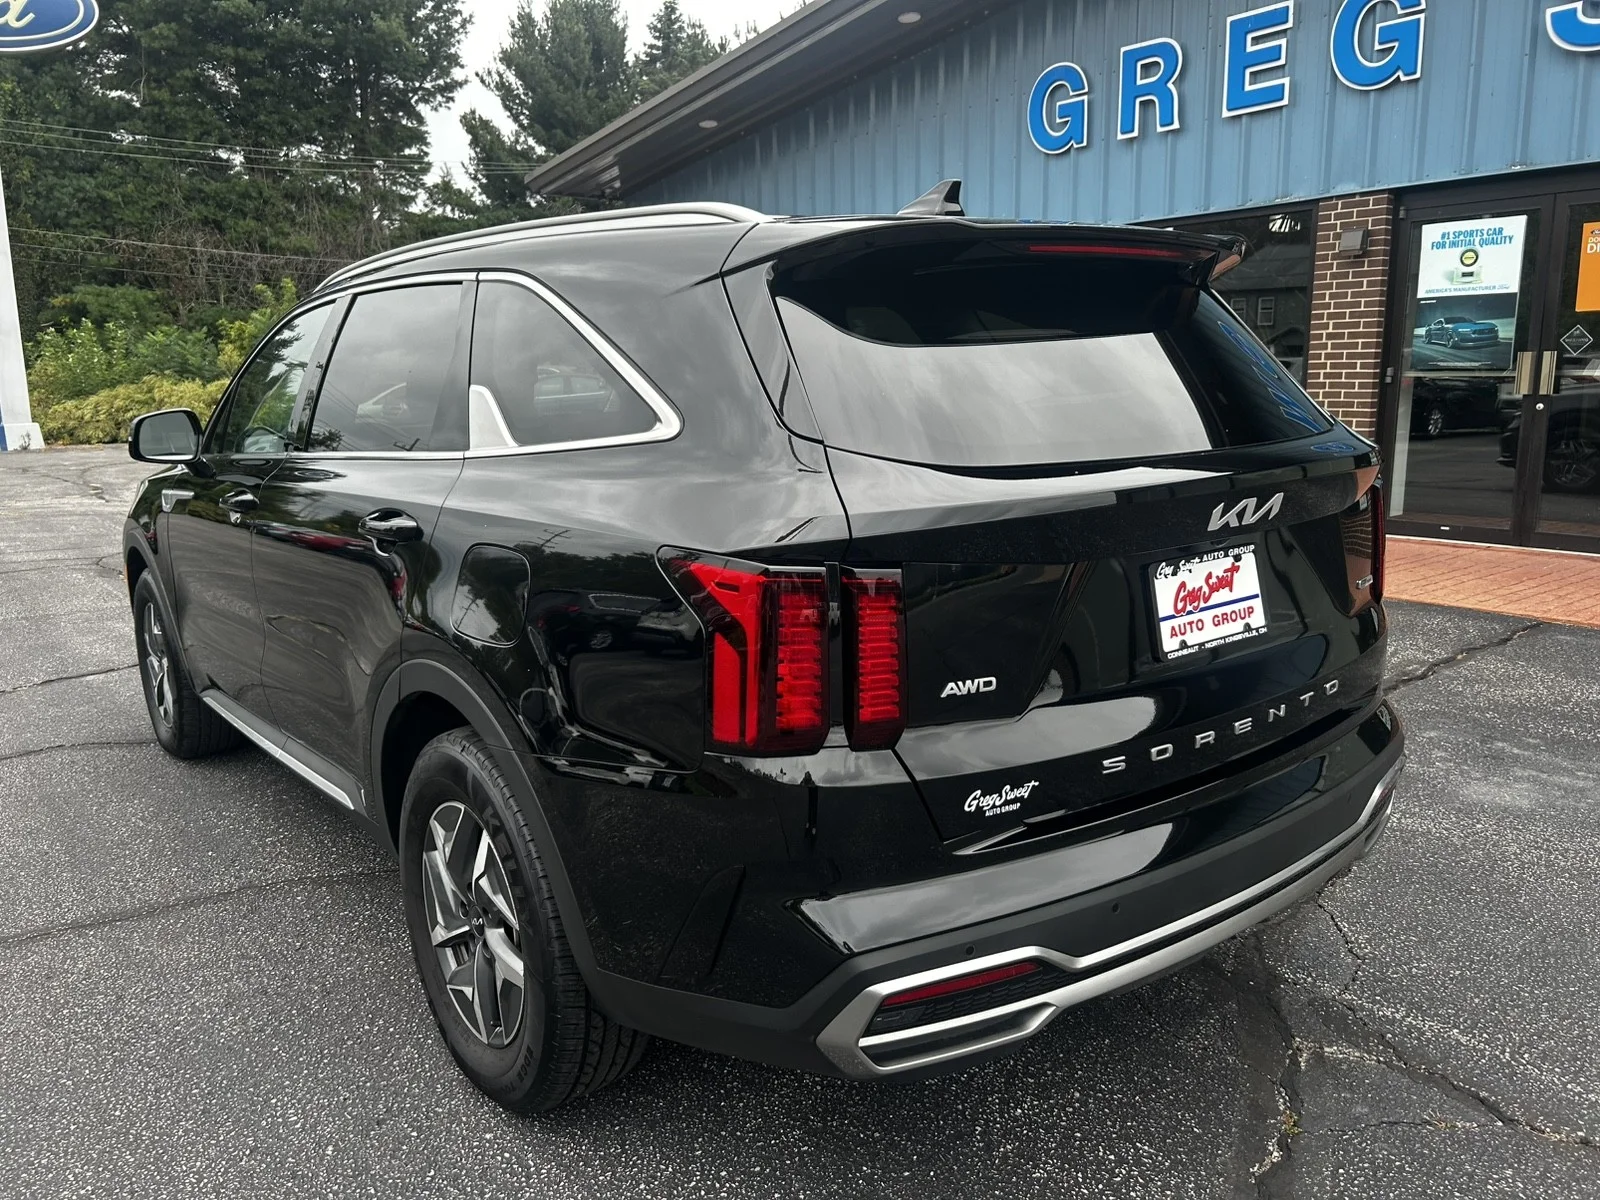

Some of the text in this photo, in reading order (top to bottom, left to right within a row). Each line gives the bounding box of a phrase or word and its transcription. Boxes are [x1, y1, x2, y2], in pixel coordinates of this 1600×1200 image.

[1027, 0, 1426, 155] GREG
[1431, 235, 1514, 250] FOR INITIAL QUALITY
[1441, 227, 1504, 240] #1 SPORTS CAR
[1453, 285, 1496, 293] MANUFACTURER
[1202, 551, 1225, 562] AUTO
[1228, 544, 1255, 557] GROUP
[1173, 561, 1240, 615] Greg Sweet
[1170, 606, 1255, 639] AUTO GROUP
[1167, 645, 1199, 660] CONNEAUT
[1205, 638, 1225, 649] NORTH
[940, 676, 997, 698] AWD
[1101, 679, 1340, 775] SORENTO
[963, 780, 1040, 812] Greg Sweet
[985, 803, 1021, 817] AUTO GROUP
